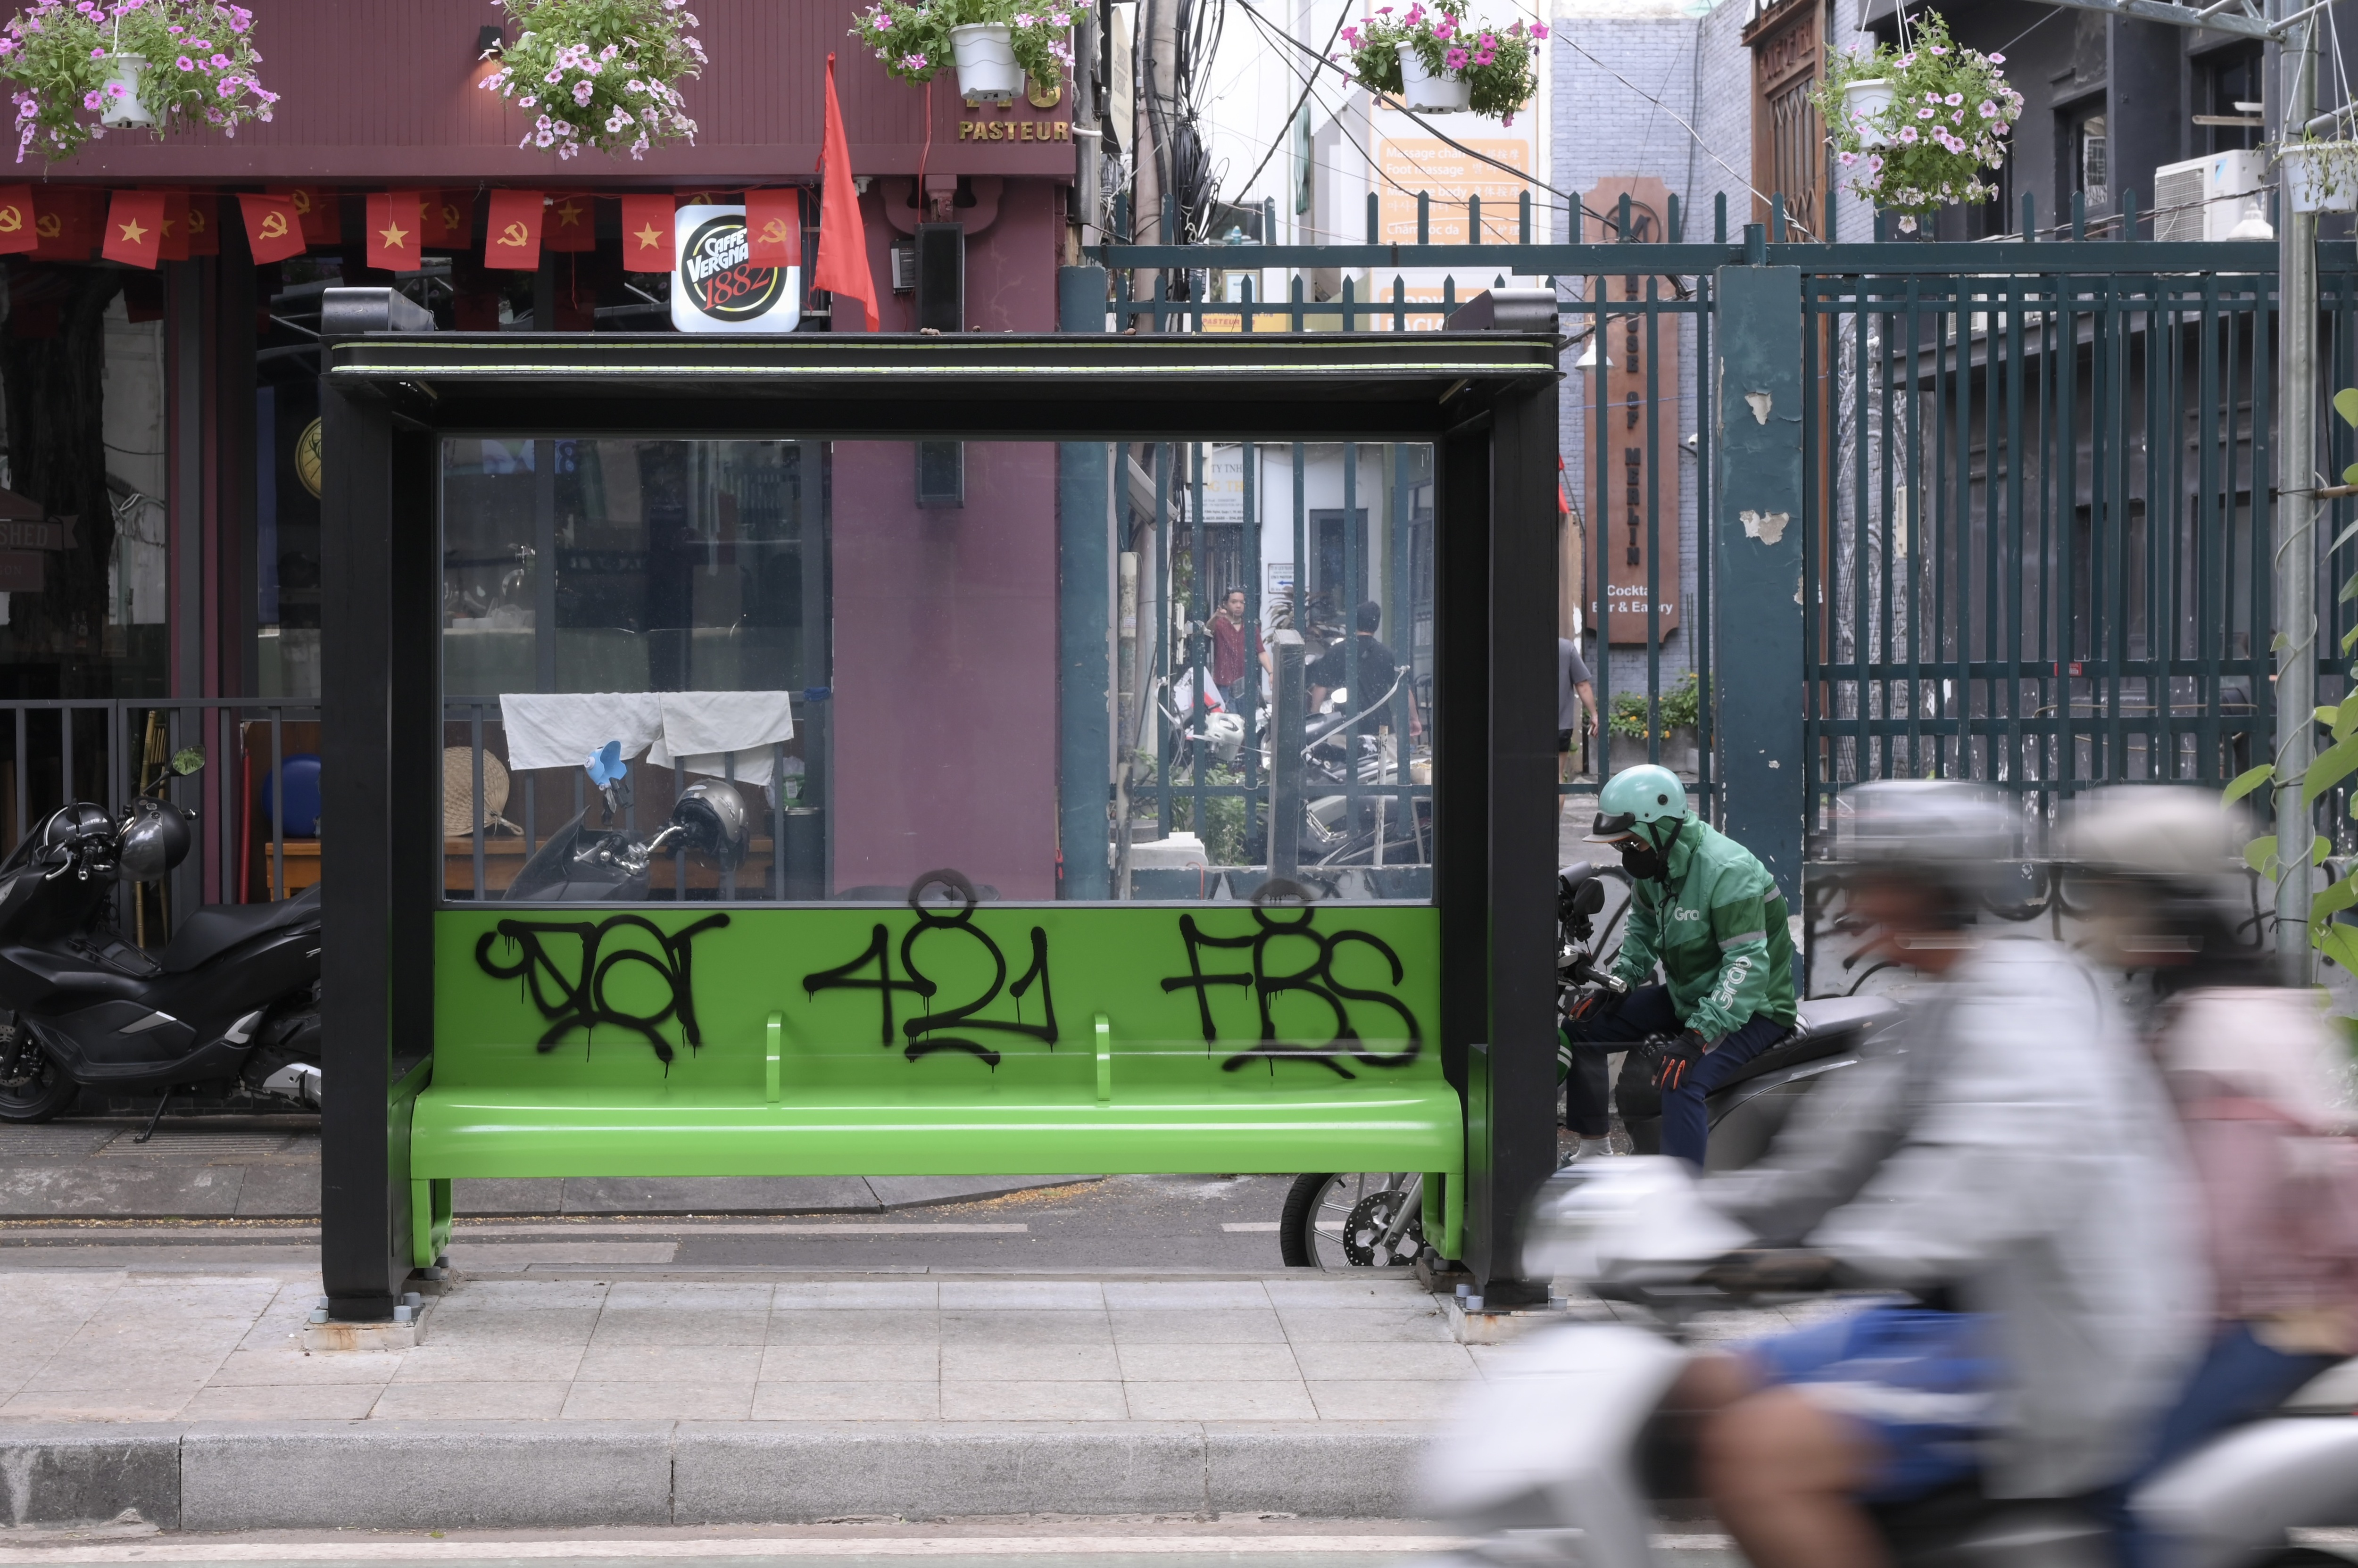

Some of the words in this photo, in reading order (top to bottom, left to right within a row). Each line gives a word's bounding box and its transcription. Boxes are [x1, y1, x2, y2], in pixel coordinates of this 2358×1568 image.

[959, 121, 1068, 140] PASTEUR
[1387, 148, 1435, 160] Massage
[1387, 164, 1411, 174] Foot
[1415, 166, 1464, 177] massage
[1438, 186, 1467, 199] body
[1445, 224, 1459, 235] da
[703, 264, 770, 310] 1882
[1625, 448, 1641, 565] MERLIN
[1619, 601, 1627, 613] &
[803, 889, 1058, 1065] 421
[1161, 894, 1421, 1073] FBS
[1711, 956, 1752, 1011] Grab
